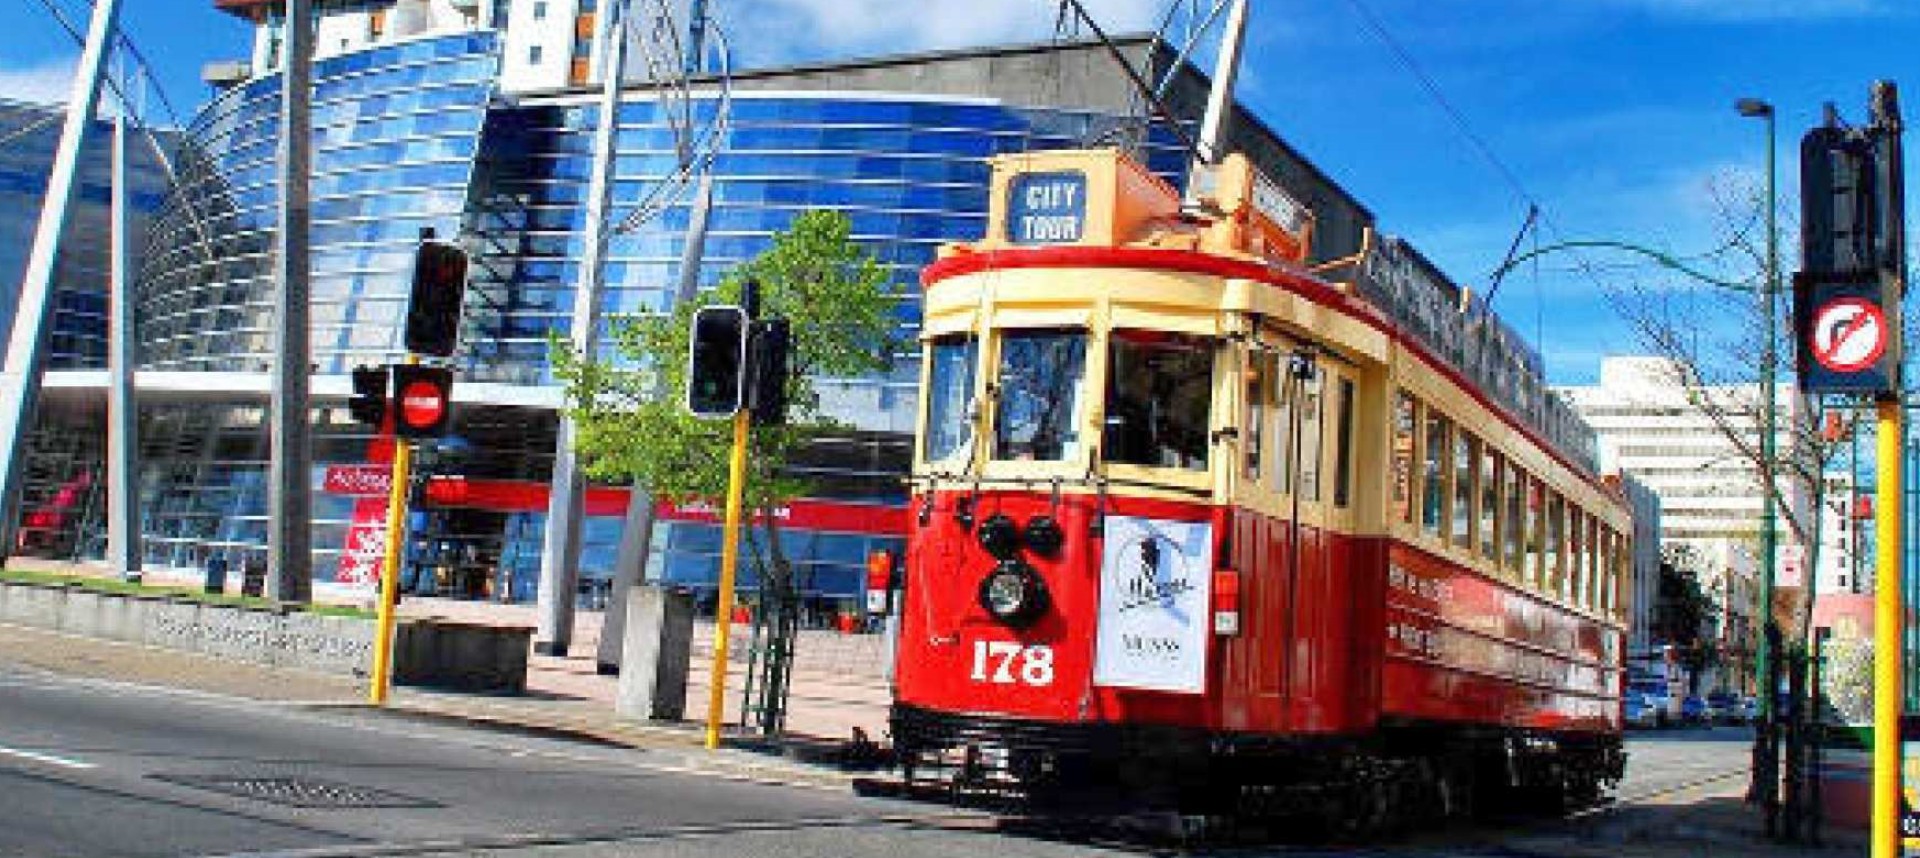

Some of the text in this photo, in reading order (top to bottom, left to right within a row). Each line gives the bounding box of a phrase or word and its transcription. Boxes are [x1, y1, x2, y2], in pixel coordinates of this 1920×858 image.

[1026, 181, 1076, 210] CITY
[1023, 215, 1078, 240] TOUR
[970, 640, 1054, 687] 178
